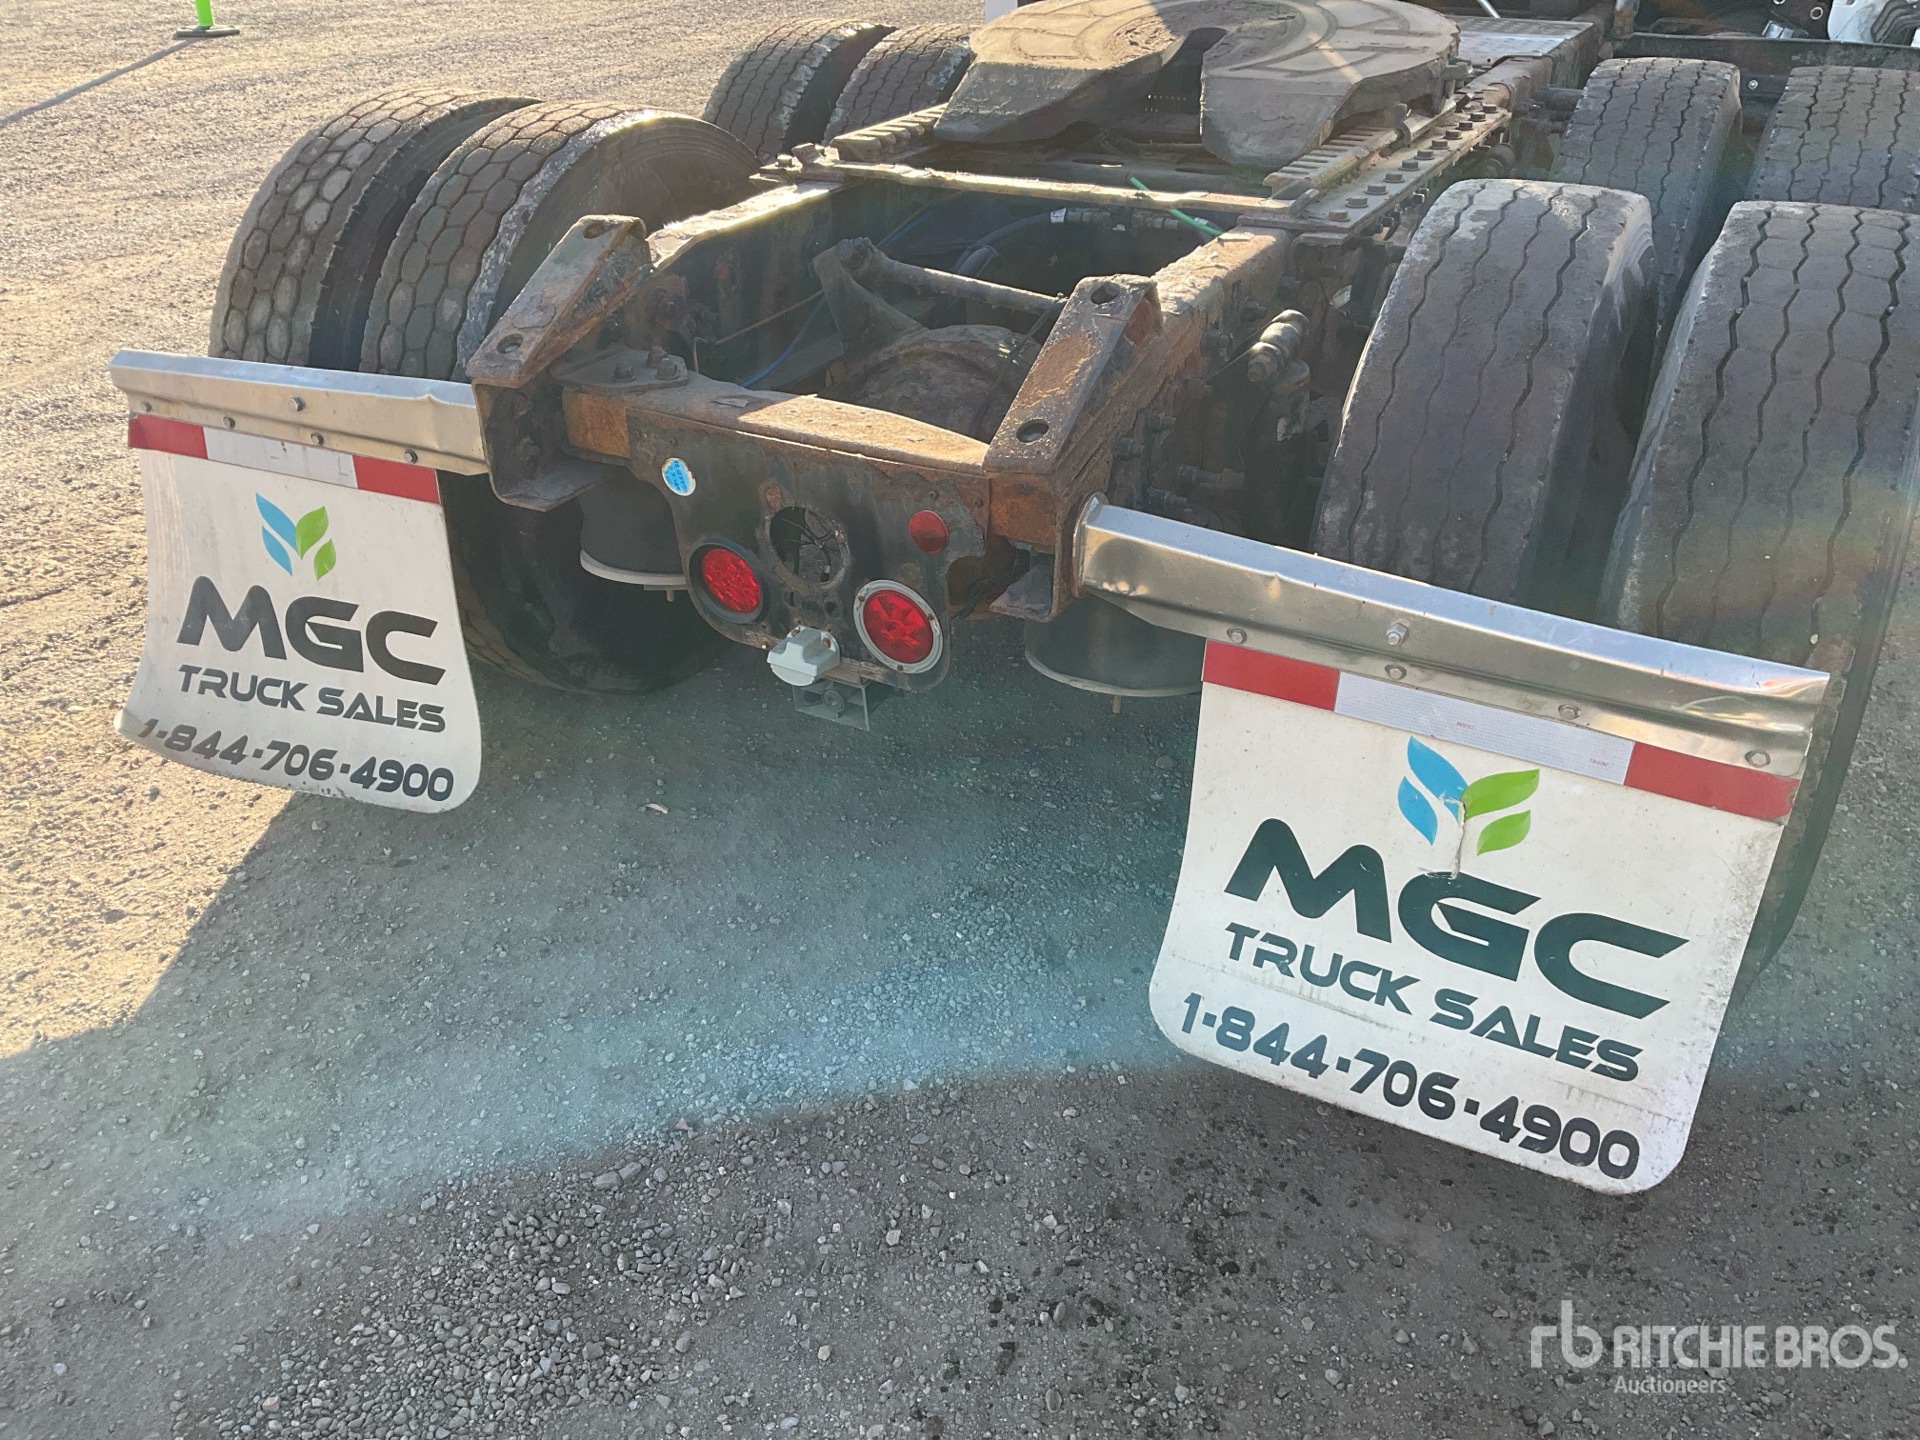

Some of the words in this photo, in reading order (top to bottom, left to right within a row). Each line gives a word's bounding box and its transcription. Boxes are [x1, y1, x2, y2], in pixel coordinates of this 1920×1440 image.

[177, 576, 446, 685] MGC
[138, 718, 454, 801] 1-844-706-4900
[178, 664, 309, 711] TRUCK
[316, 687, 446, 733] SALES
[1224, 818, 1690, 1019] MGC
[1224, 922, 1421, 1015] TRUCK
[1429, 988, 1641, 1082] SALES
[1181, 993, 1640, 1179] 1-844-706-4900
